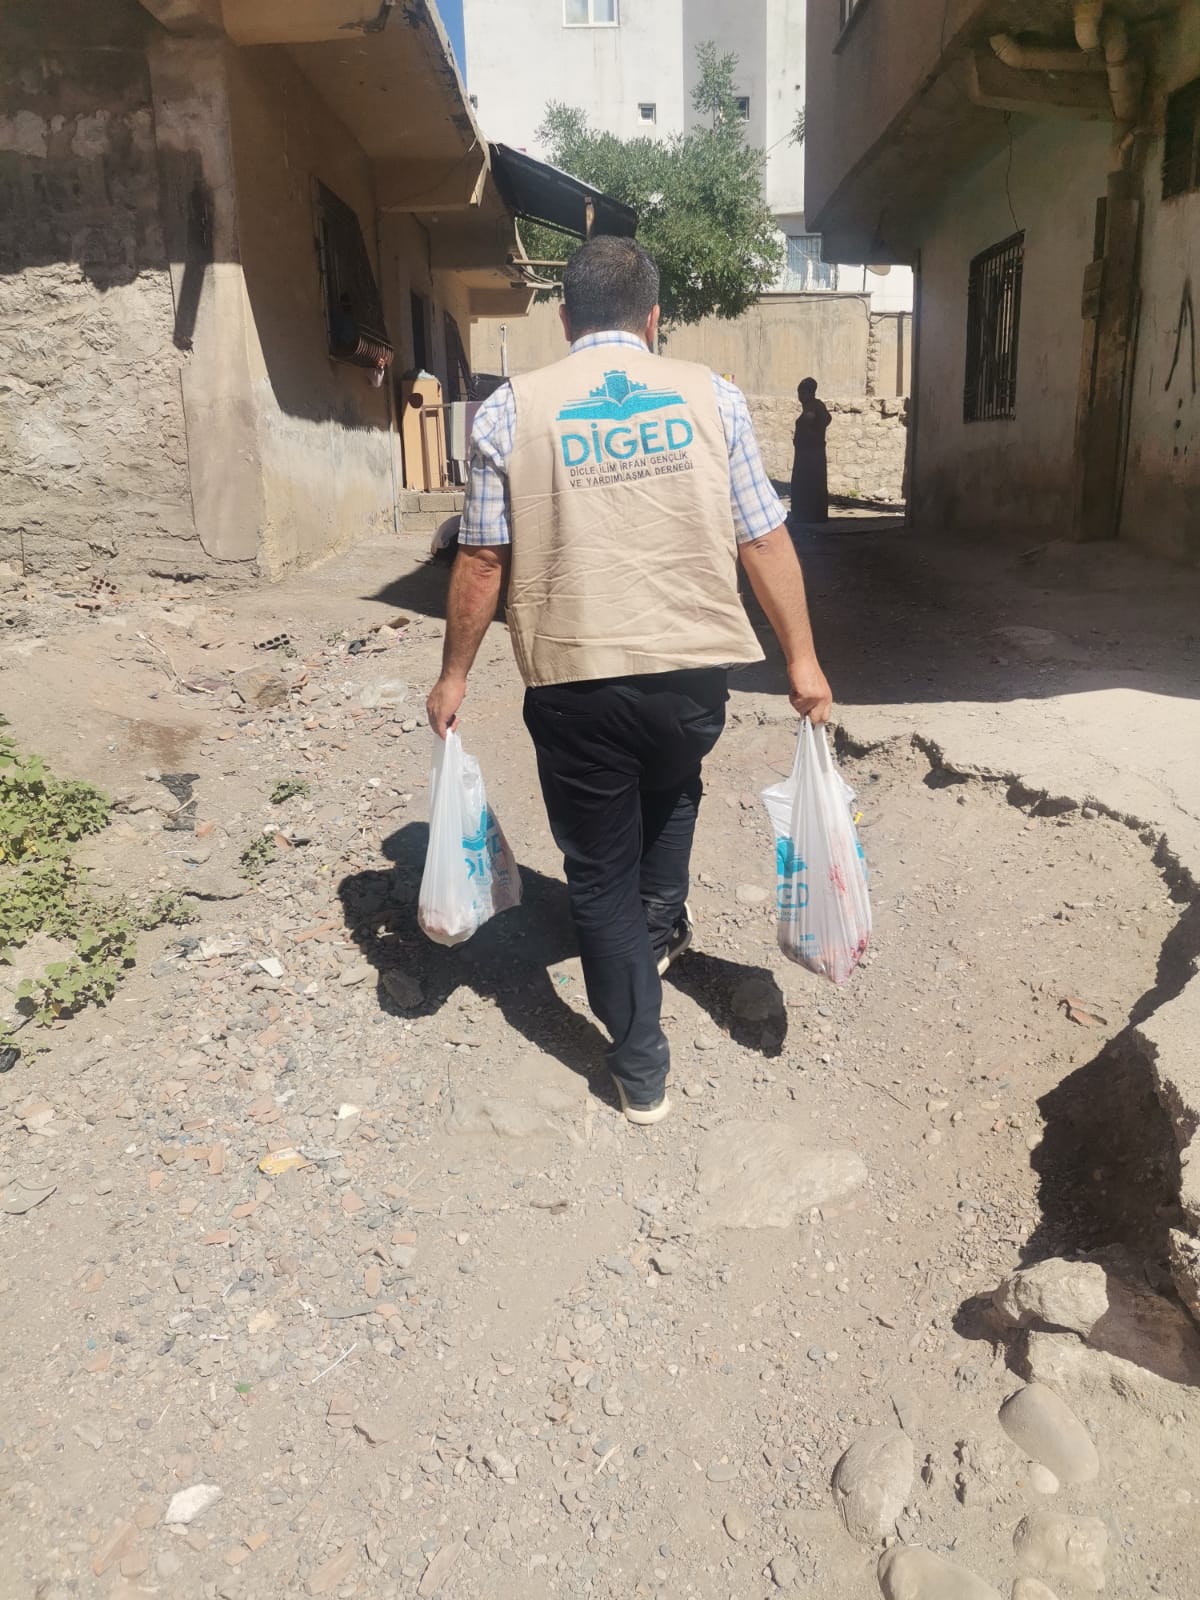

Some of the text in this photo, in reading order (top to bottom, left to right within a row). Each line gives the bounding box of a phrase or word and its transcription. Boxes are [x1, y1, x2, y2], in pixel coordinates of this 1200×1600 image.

[561, 417, 694, 467] DİGED
[569, 459, 694, 488] VE YARDIMLAŞMA DERNEĞİ
[570, 465, 596, 477] DİCLE
[650, 450, 688, 465] GENÇLİK
